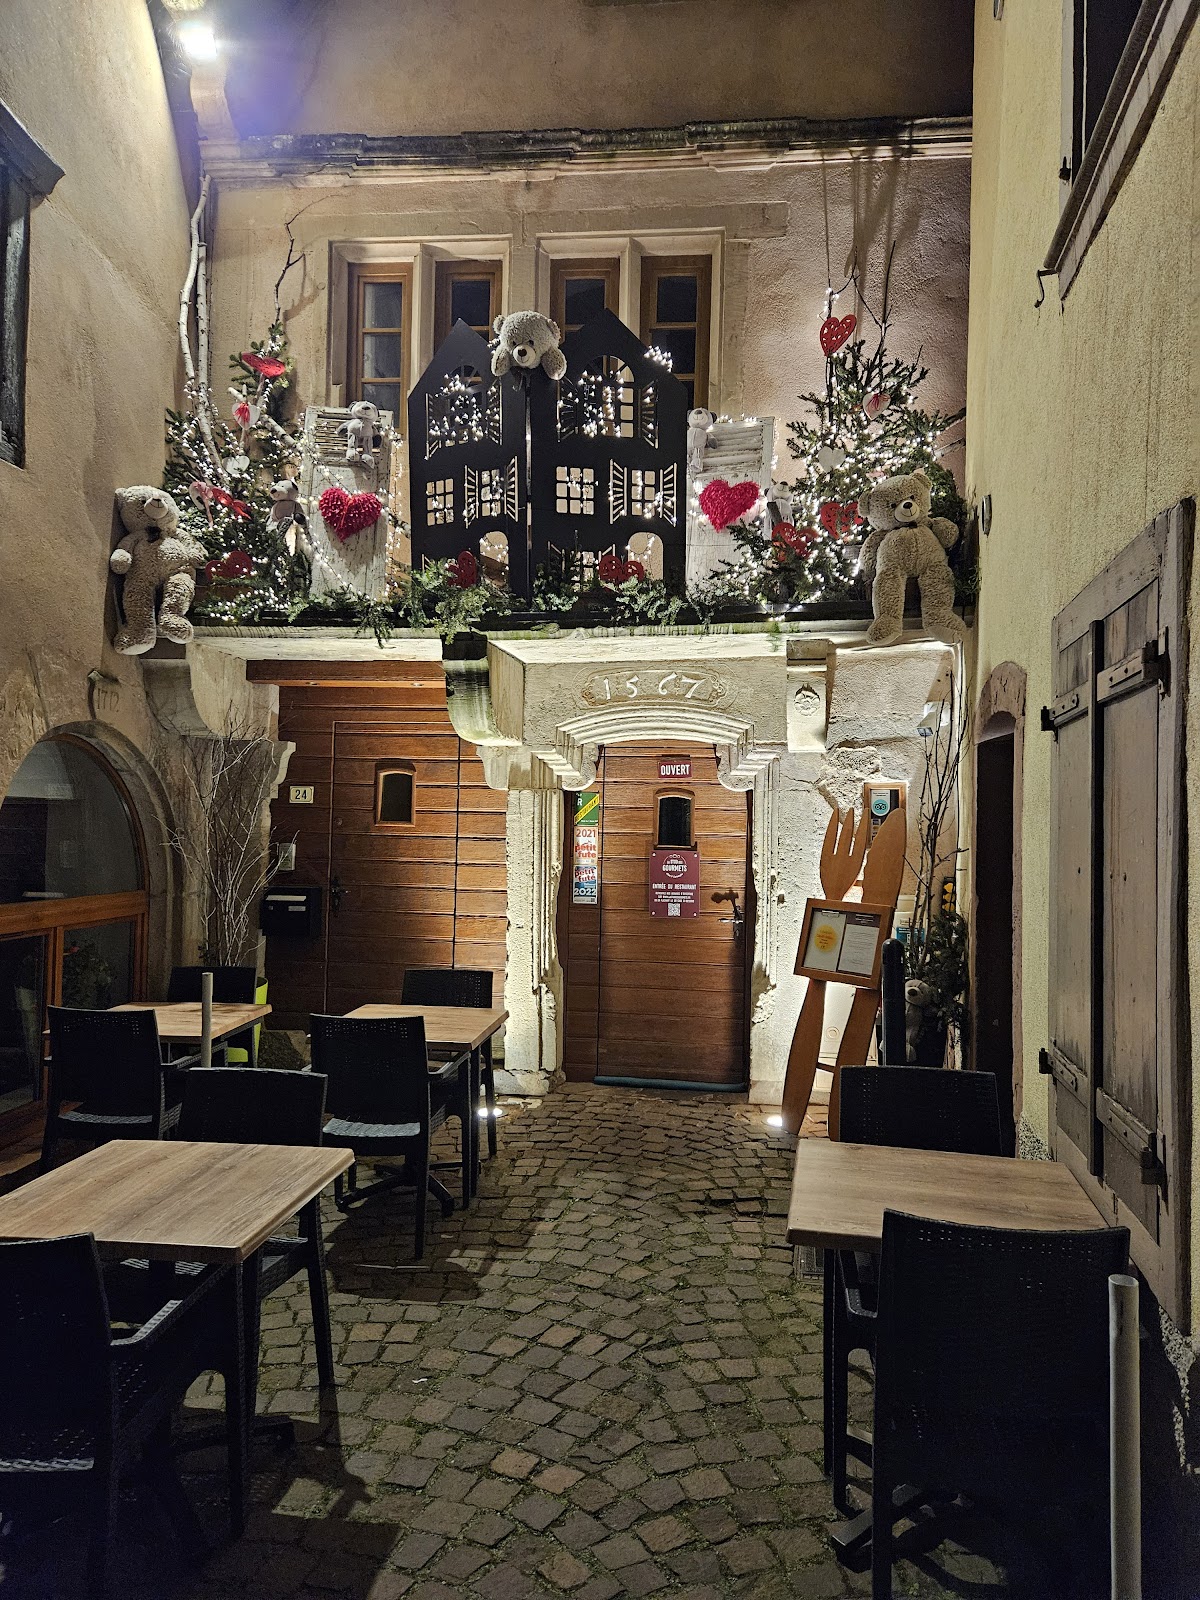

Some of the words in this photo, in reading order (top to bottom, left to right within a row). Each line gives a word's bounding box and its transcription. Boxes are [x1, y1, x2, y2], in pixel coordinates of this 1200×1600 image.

[603, 671, 706, 700] 1567
[660, 764, 691, 776] OUVERT
[295, 789, 307, 800] 24
[575, 829, 596, 838] 2021
[575, 843, 597, 853] petit
[574, 868, 595, 878] petit
[574, 887, 597, 896] 2022
